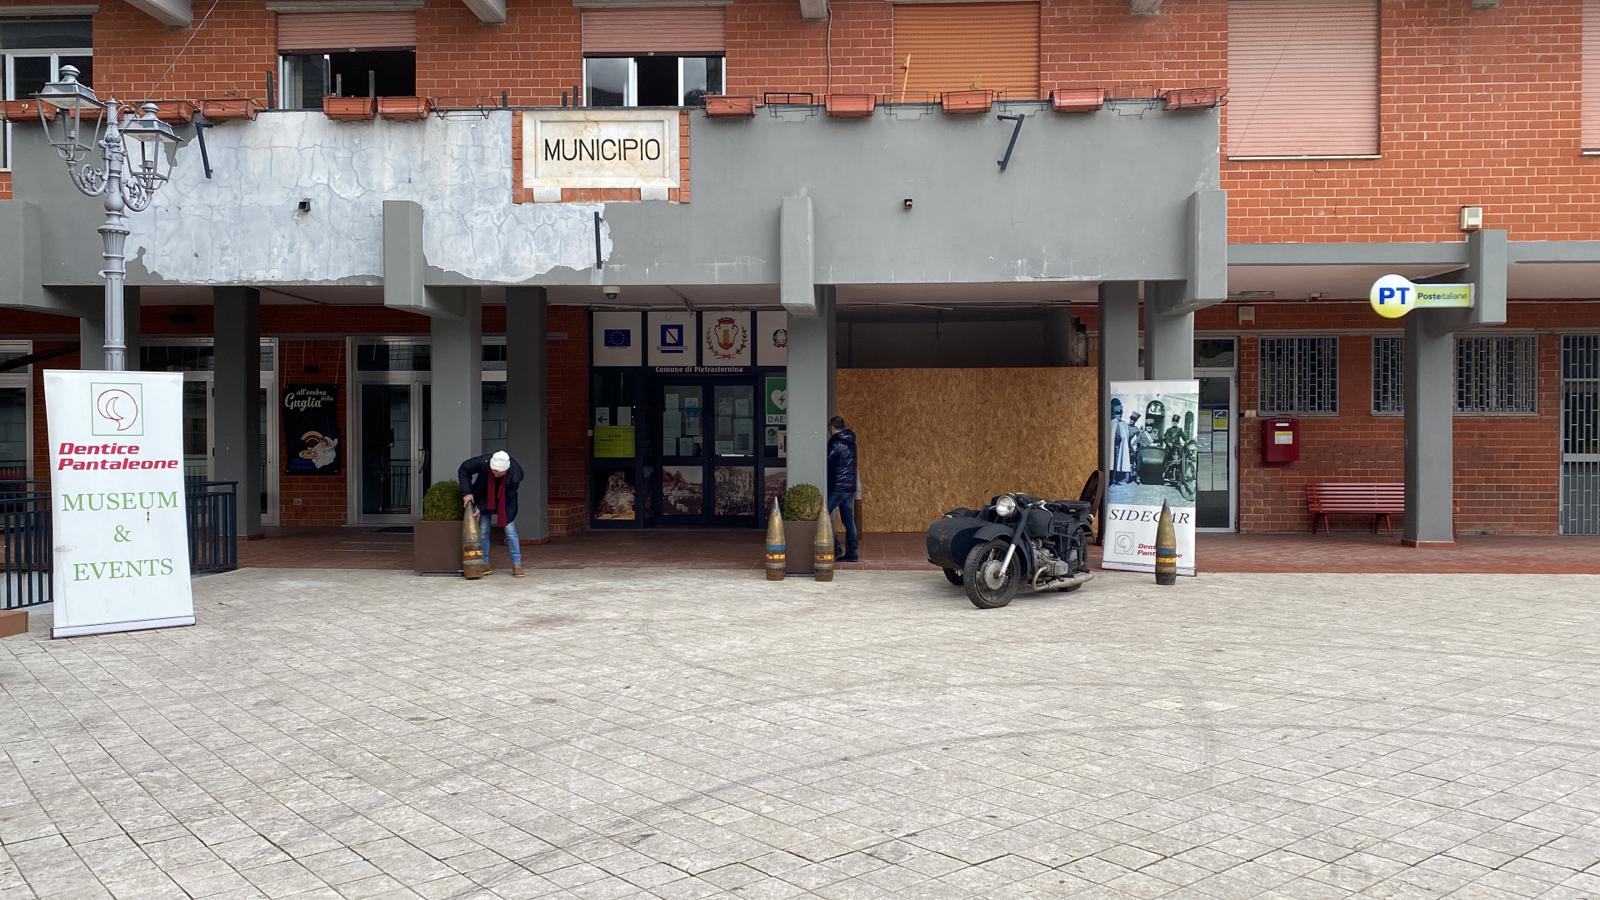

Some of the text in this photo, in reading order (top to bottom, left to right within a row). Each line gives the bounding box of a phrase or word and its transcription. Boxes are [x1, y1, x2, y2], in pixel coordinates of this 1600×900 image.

[544, 138, 661, 161] MUNICIPIO
[1379, 287, 1410, 305] PT
[284, 392, 322, 412] Guglia
[767, 415, 785, 424] DAE
[58, 442, 140, 455] Dentice
[58, 458, 179, 471] Pantaleone
[61, 491, 178, 511] MUSEUM
[113, 524, 133, 542] &
[72, 558, 174, 581] EVENTS
